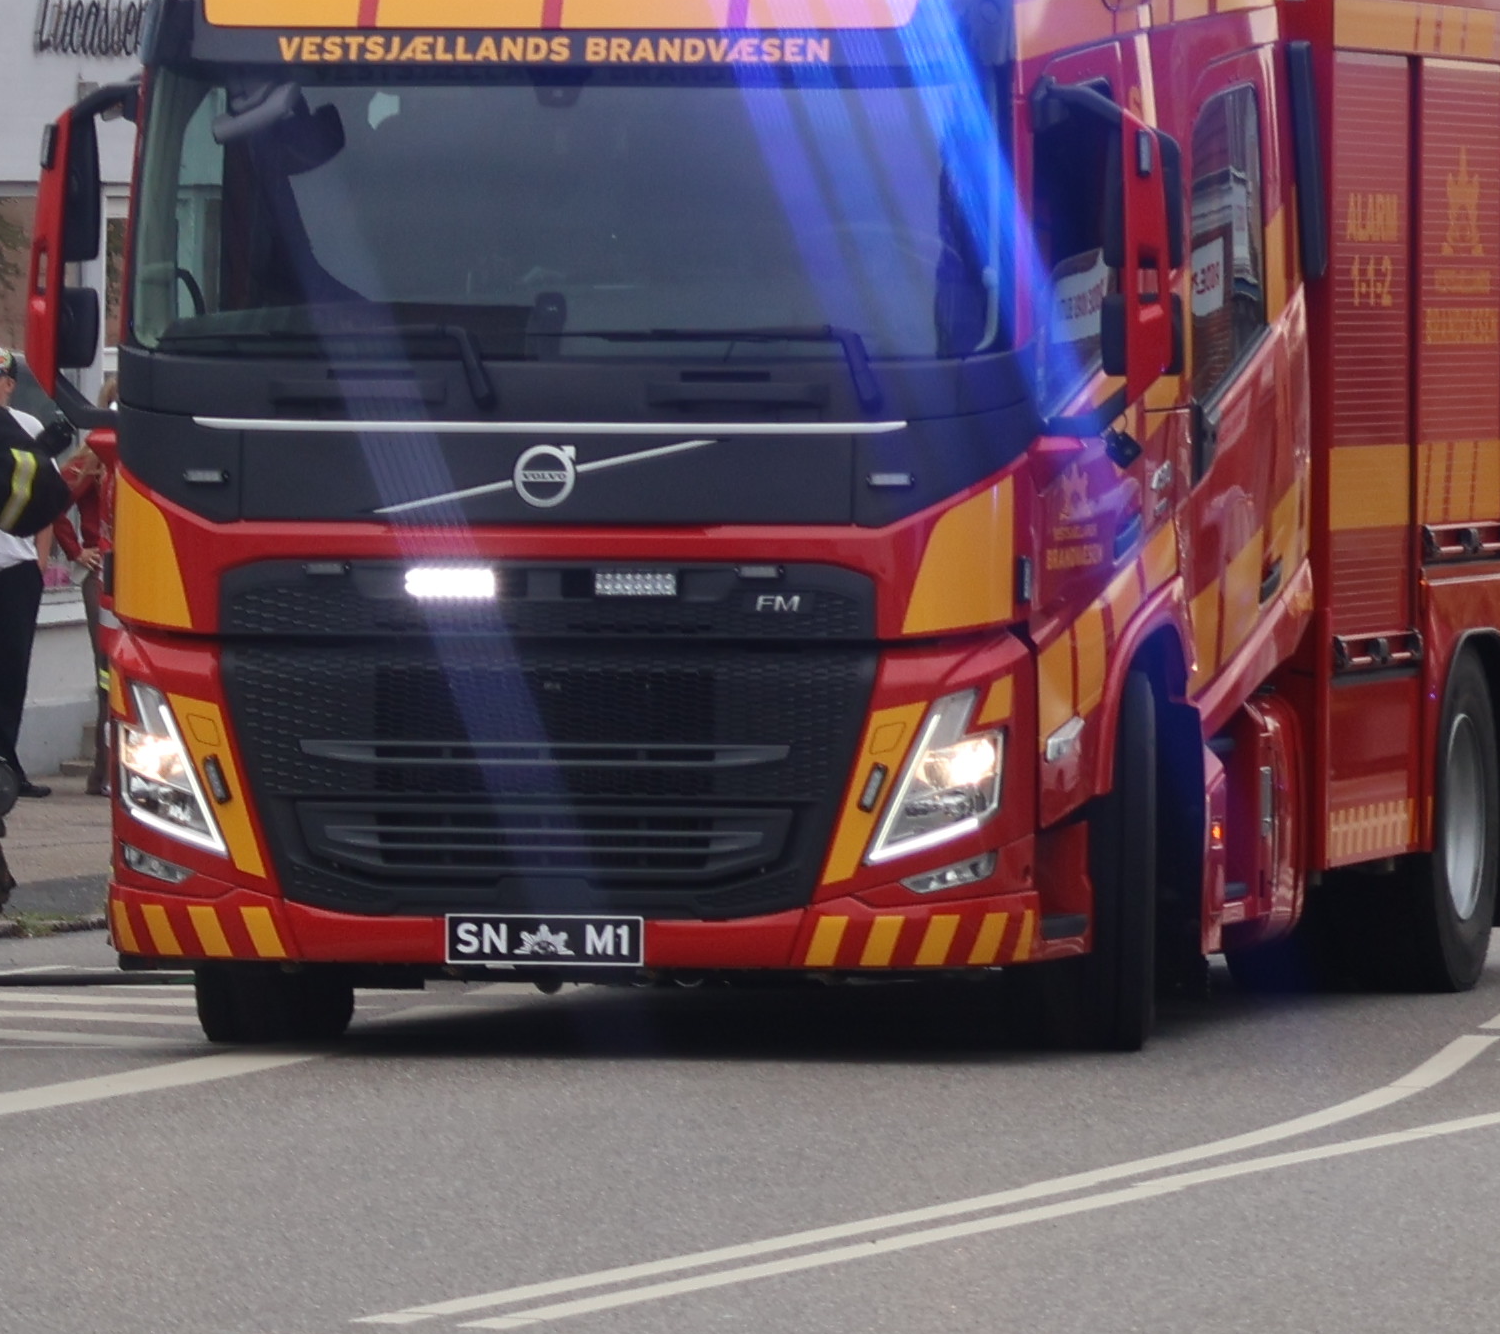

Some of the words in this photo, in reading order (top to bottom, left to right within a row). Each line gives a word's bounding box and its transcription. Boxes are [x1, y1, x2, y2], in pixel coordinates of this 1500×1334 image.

[279, 36, 571, 63] VESTSJÆLLANDS
[585, 37, 831, 64] BRANDVÆSEN
[522, 472, 567, 480] VOLVO
[756, 595, 800, 612] FM
[456, 922, 508, 954] SN
[585, 924, 631, 956] M1
